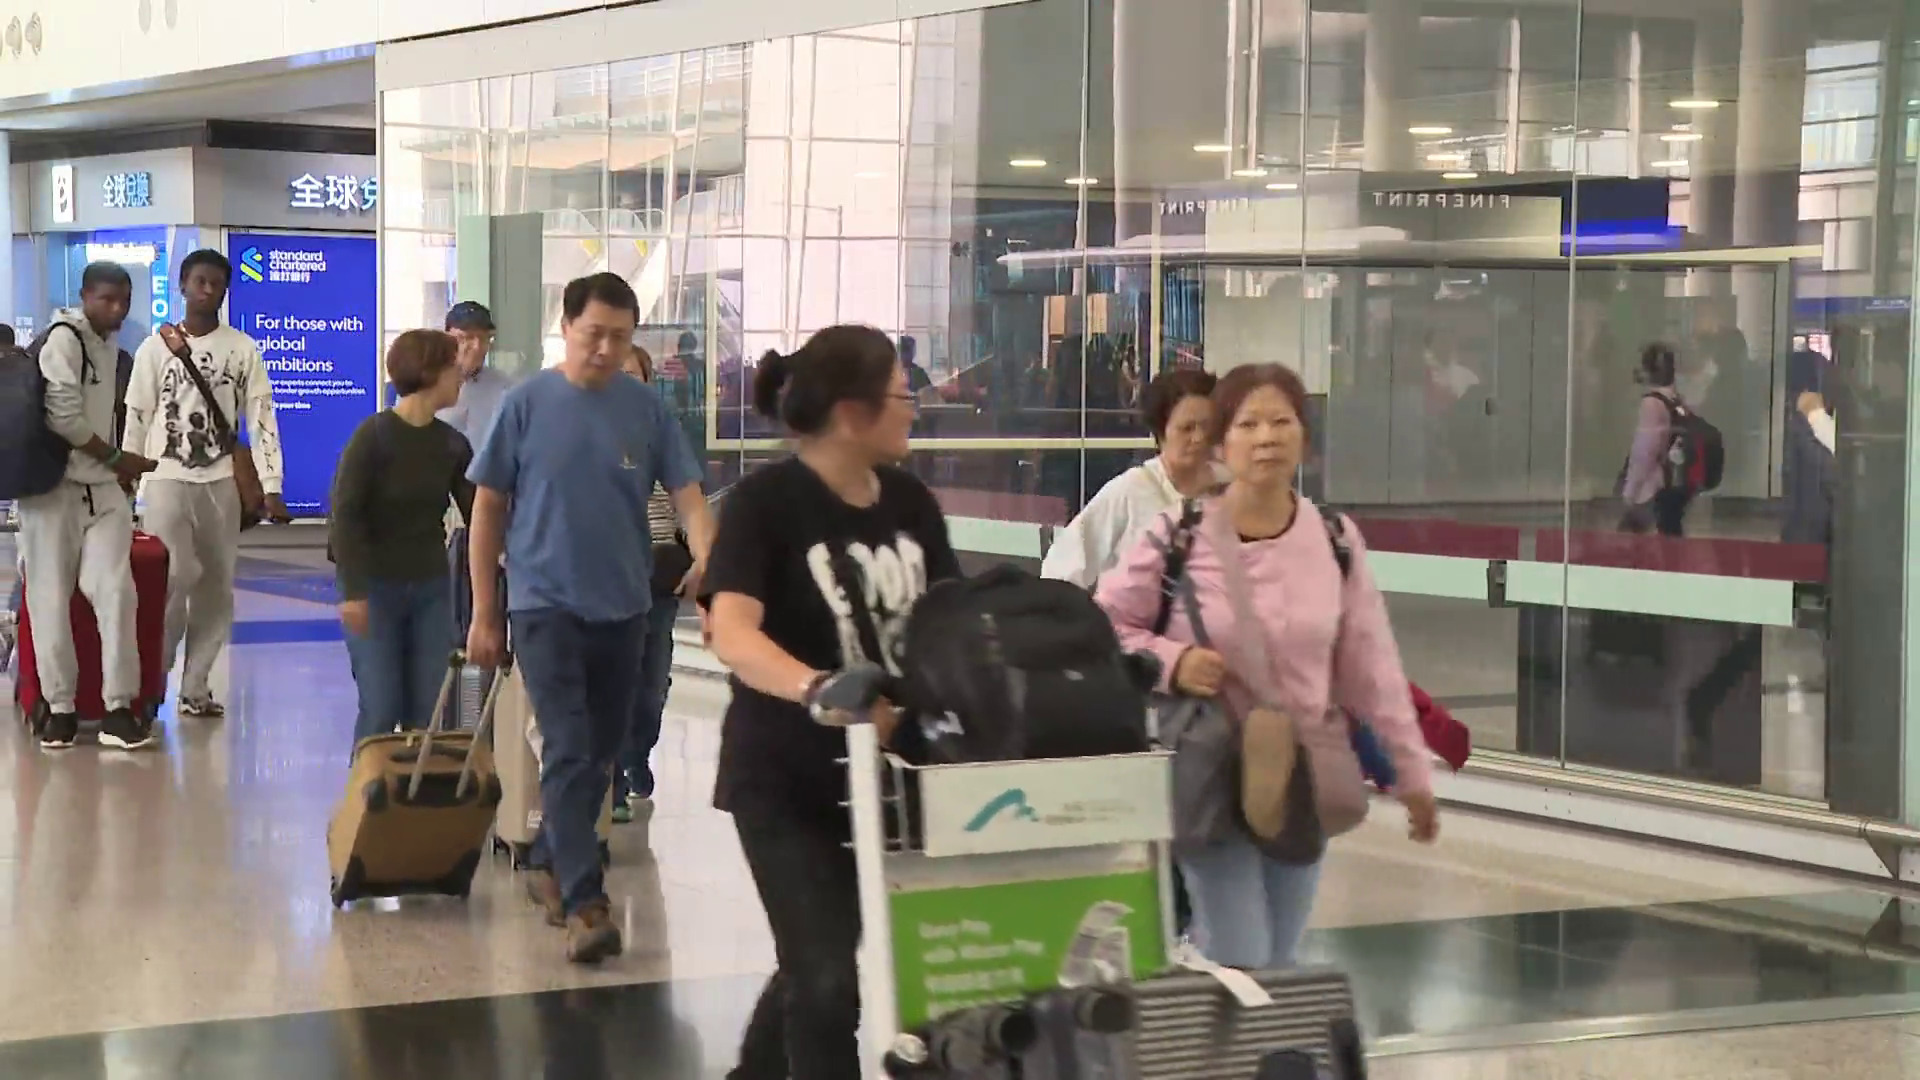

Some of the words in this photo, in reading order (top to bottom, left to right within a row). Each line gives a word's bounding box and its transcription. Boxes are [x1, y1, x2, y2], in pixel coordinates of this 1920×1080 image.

[268, 249, 323, 261] standard
[268, 260, 327, 272] chartered
[255, 313, 280, 329] For
[284, 315, 327, 331] those
[330, 316, 364, 331] with
[255, 335, 305, 352] global
